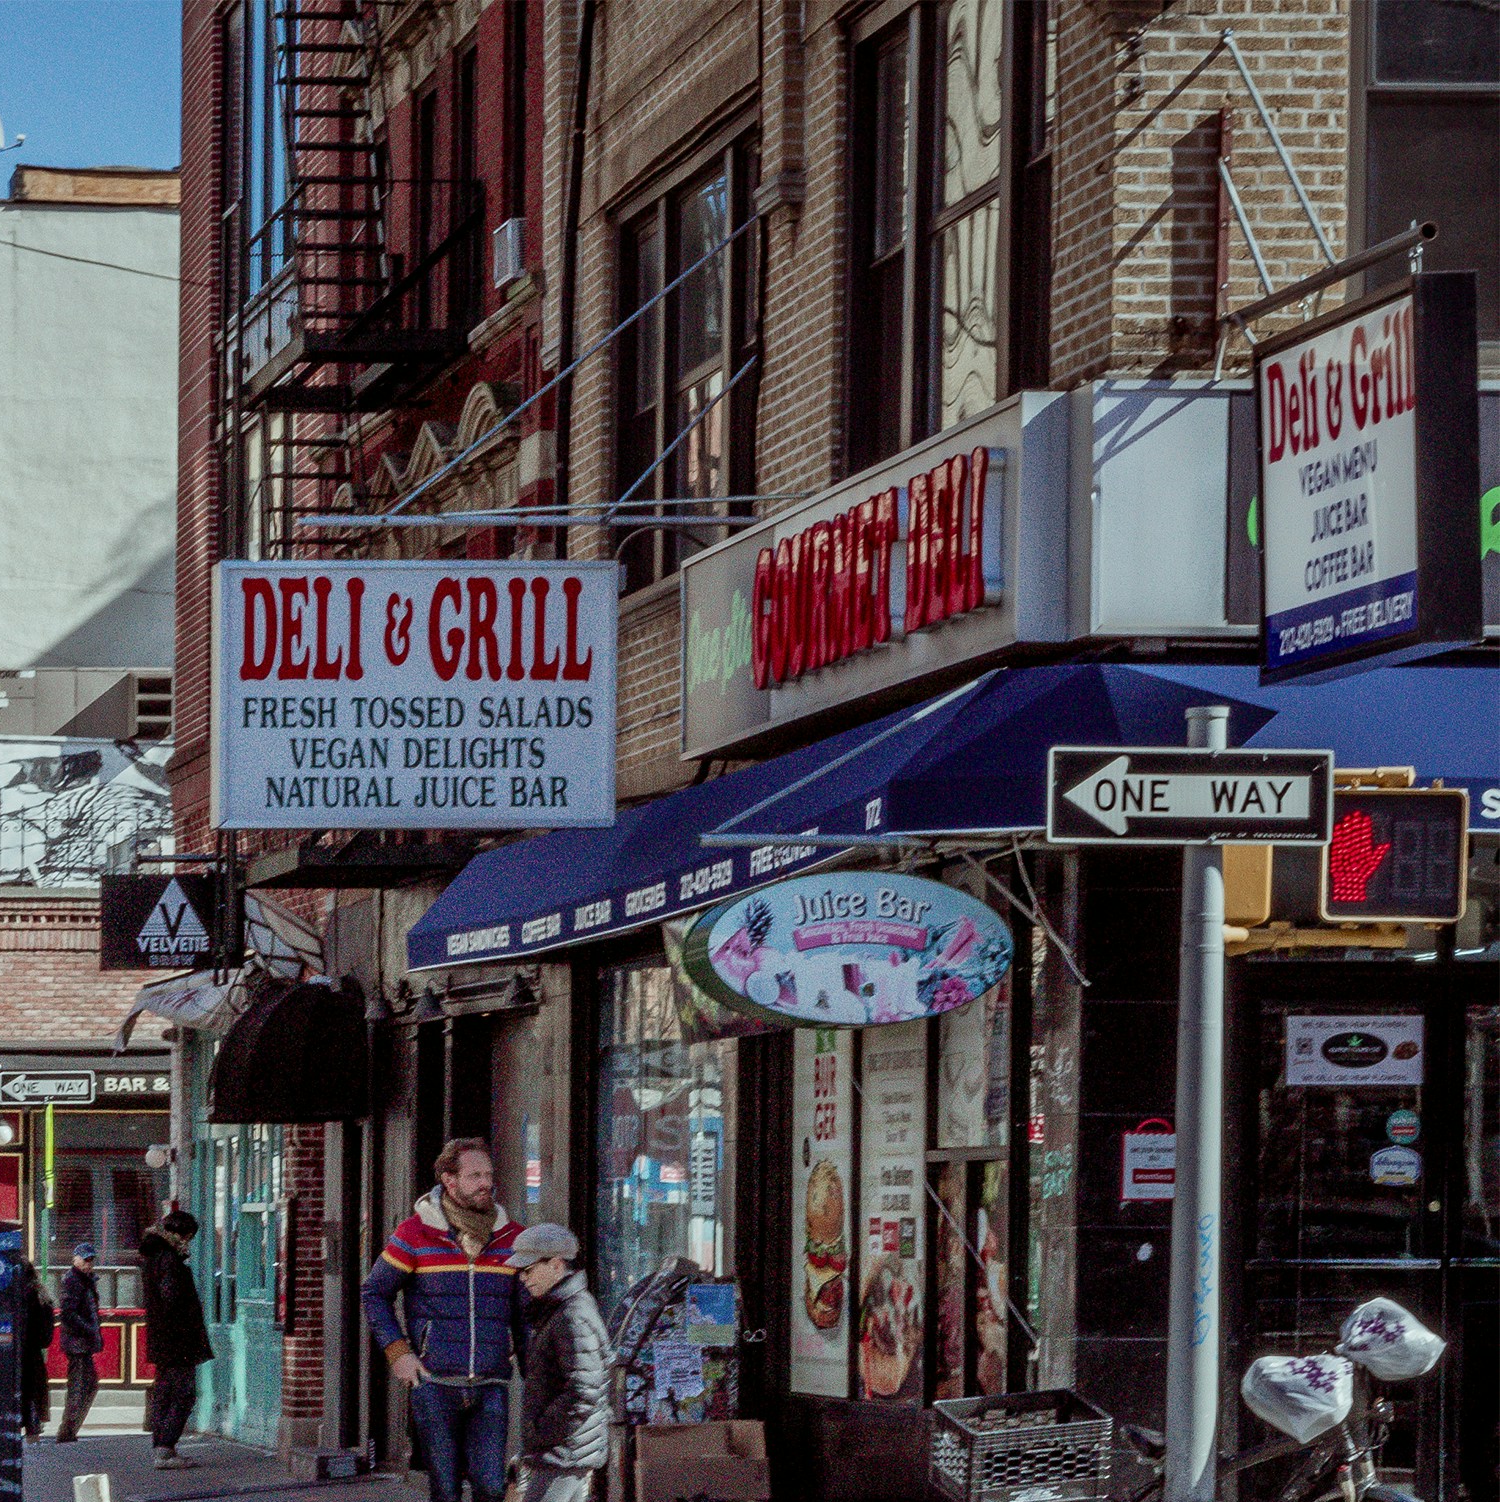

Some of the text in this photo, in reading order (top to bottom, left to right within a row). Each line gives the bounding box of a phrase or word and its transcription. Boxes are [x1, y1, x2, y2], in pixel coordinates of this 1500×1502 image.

[1267, 304, 1415, 464] Deli & Grill
[1299, 438, 1378, 496] VEGAN MENU
[1310, 493, 1368, 543] JUICE BAR
[752, 486, 899, 690] GOURMET
[904, 445, 989, 635] DELI
[1304, 540, 1375, 593] COFFEE BAR
[239, 576, 365, 682] DELI
[384, 592, 413, 667] &
[428, 576, 593, 682] GRILL
[242, 697, 594, 728] FRESH TOSSED SALADS
[289, 737, 546, 769] VEGAN DELIGHTS
[265, 776, 569, 808] NATURAL JUICE BAR
[1094, 778, 1293, 813] ONE WAY
[794, 887, 933, 925] Juice Bar
[136, 936, 210, 955] VELVETTE
[12, 1081, 85, 1094] ONE WAY
[104, 1077, 171, 1092] BAR &
